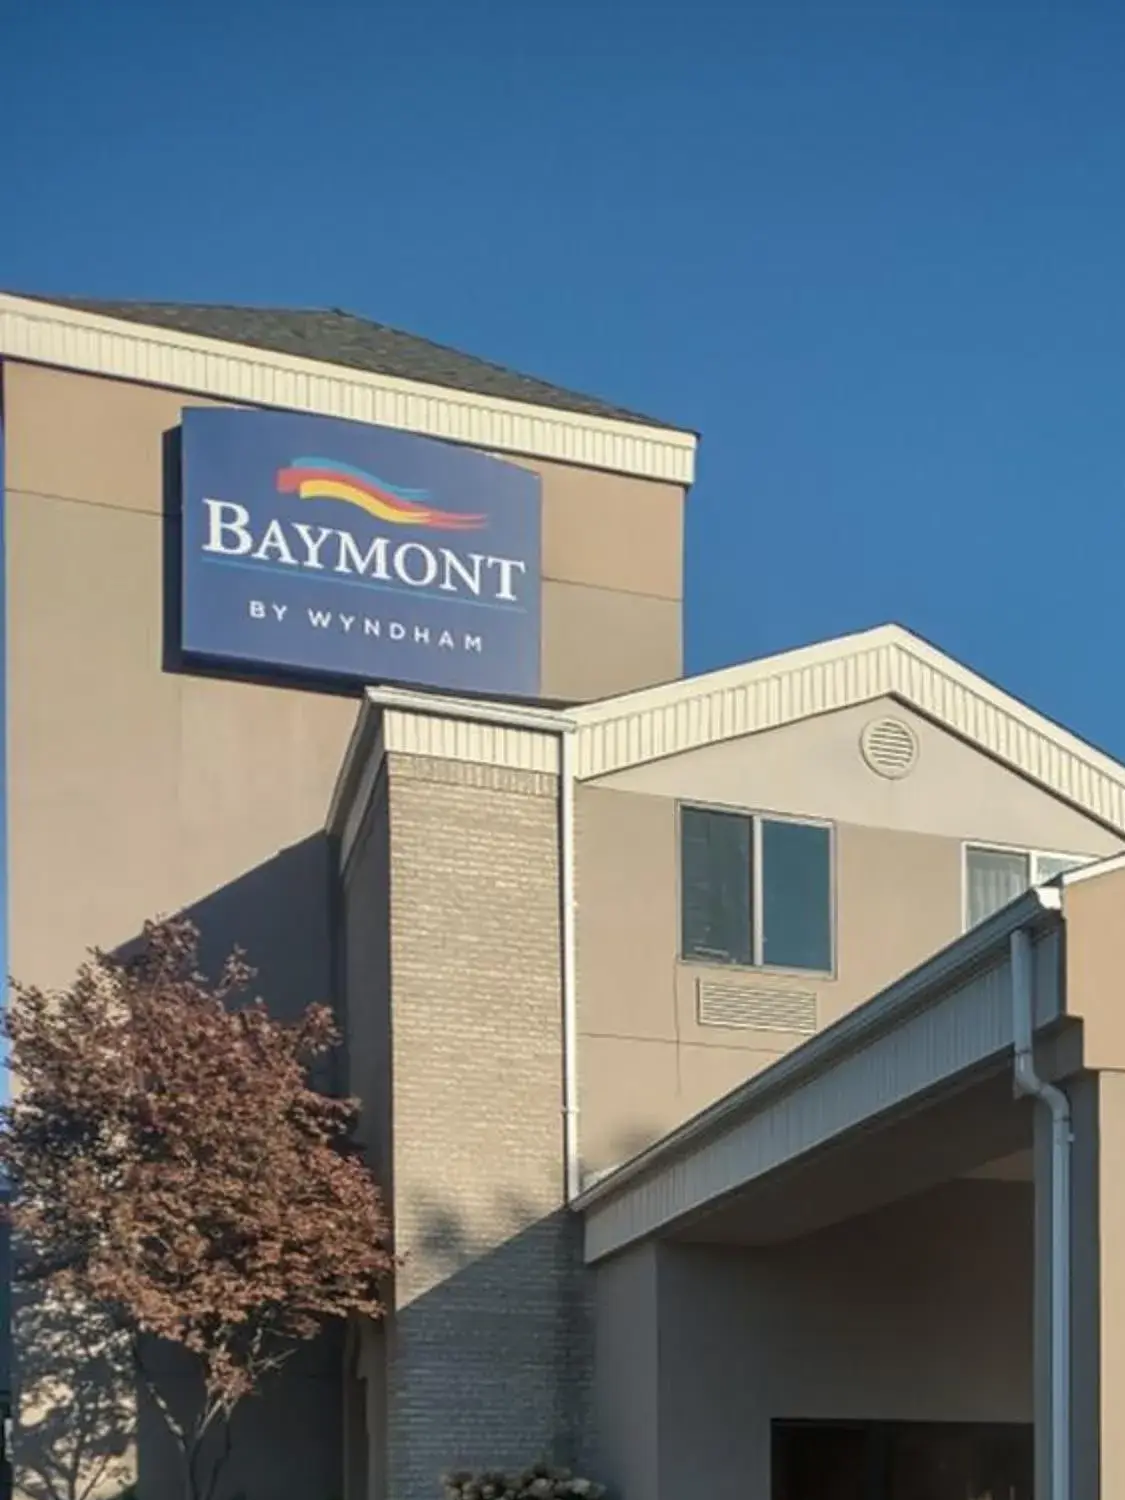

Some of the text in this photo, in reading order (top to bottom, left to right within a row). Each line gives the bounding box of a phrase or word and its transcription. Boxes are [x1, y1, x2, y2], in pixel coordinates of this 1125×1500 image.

[202, 498, 526, 601] BAYMONT
[249, 600, 483, 652] BY WYNDHAM
